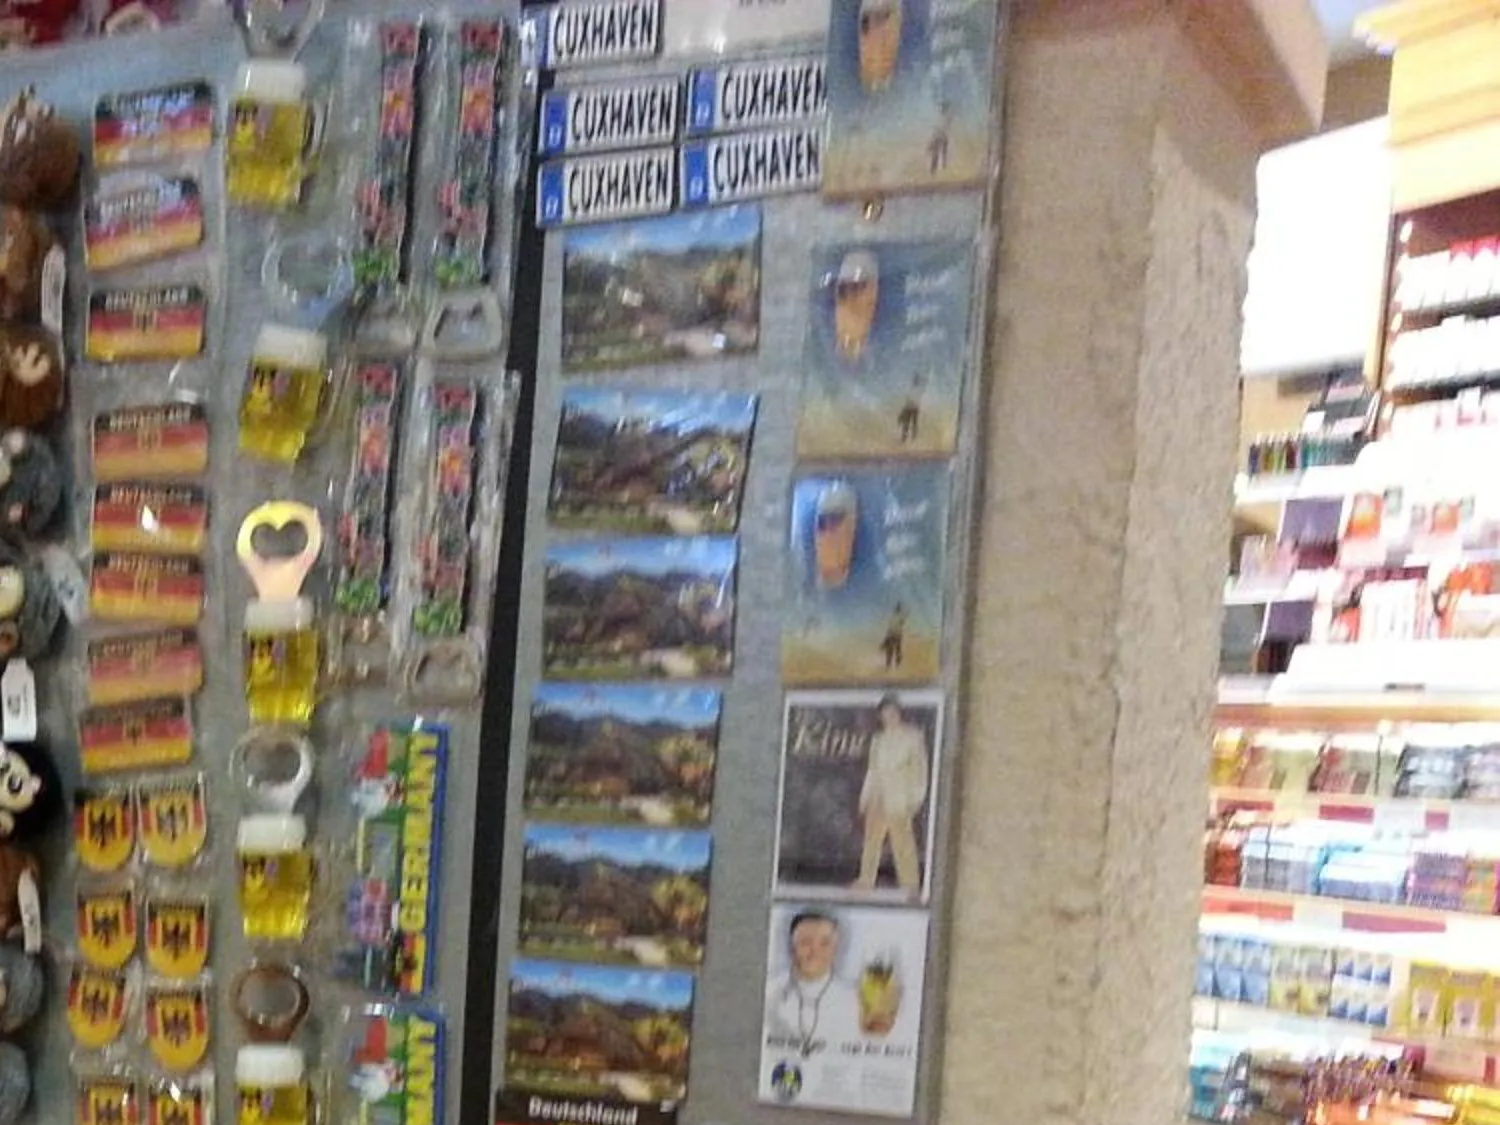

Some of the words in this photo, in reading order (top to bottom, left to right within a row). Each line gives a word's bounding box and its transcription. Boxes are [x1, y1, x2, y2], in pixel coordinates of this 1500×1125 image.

[553, 0, 656, 58] CUXHAVEN
[571, 88, 673, 142] CUXHAVEN
[720, 63, 827, 122] CUXHAVEN
[567, 157, 670, 214] CUXHAVEN
[713, 132, 820, 193] CUXHAVEN
[399, 731, 439, 933] GERMANY
